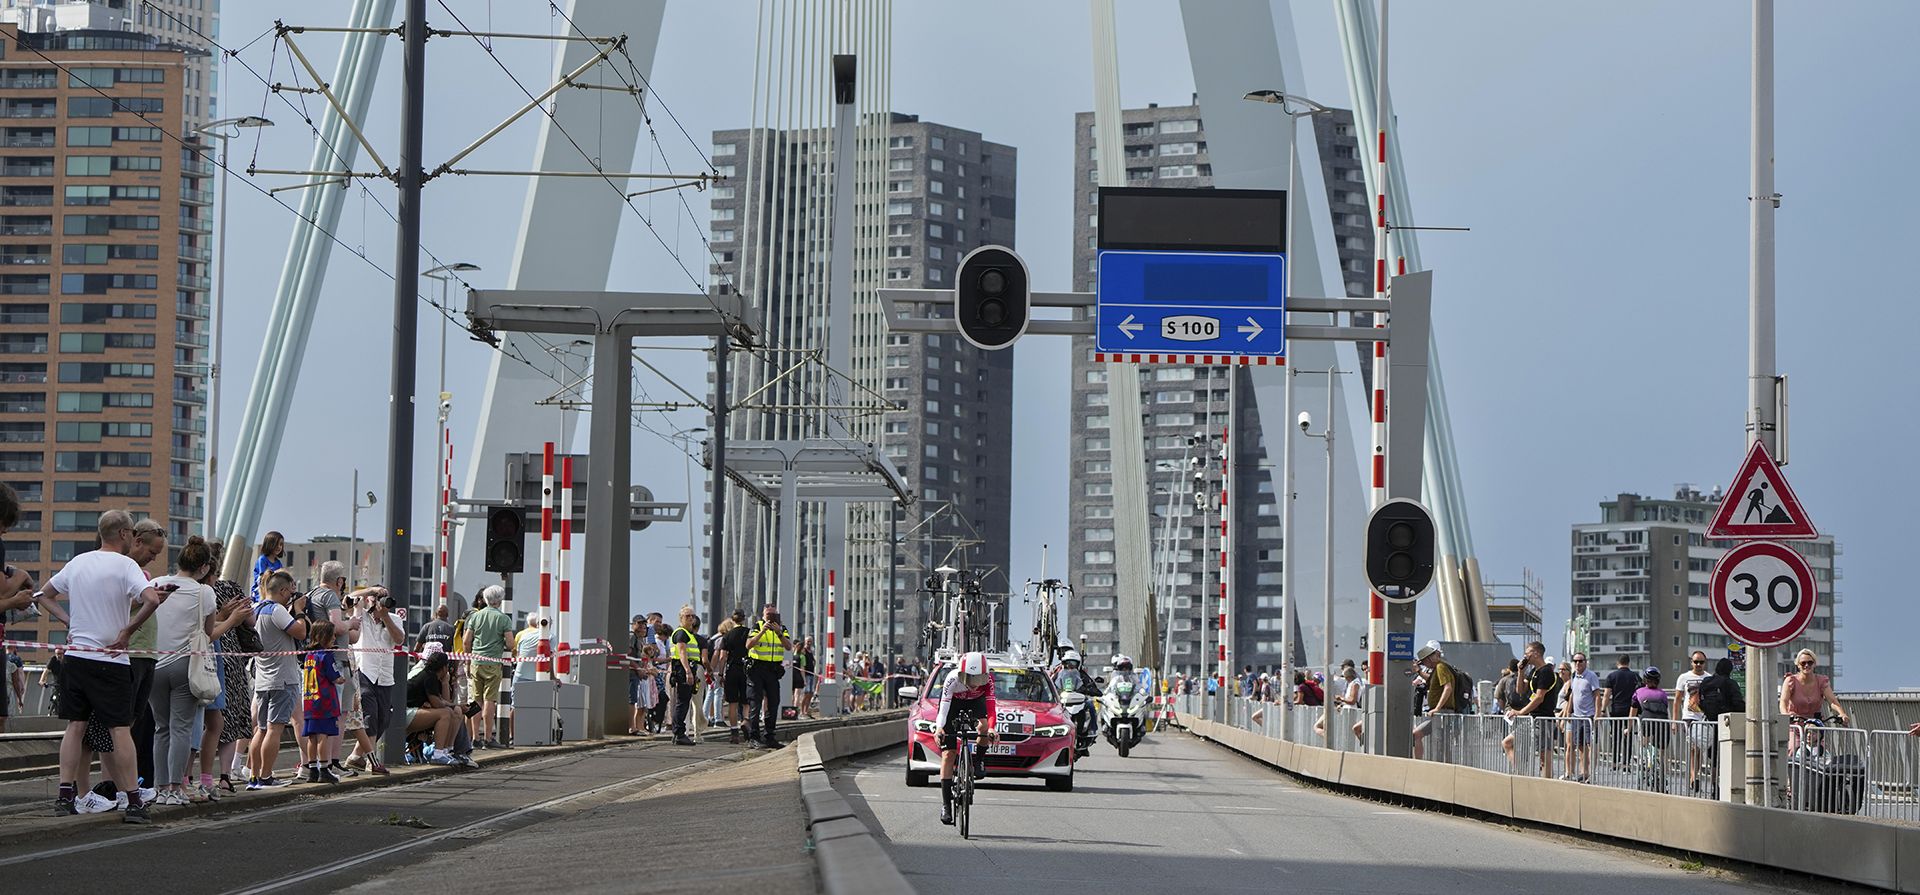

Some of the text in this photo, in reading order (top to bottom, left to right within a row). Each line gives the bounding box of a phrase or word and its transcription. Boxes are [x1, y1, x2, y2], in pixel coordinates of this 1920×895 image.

[1167, 321, 1215, 335] S 100
[1730, 573, 1799, 614] 30
[997, 713, 1024, 722] SOT
